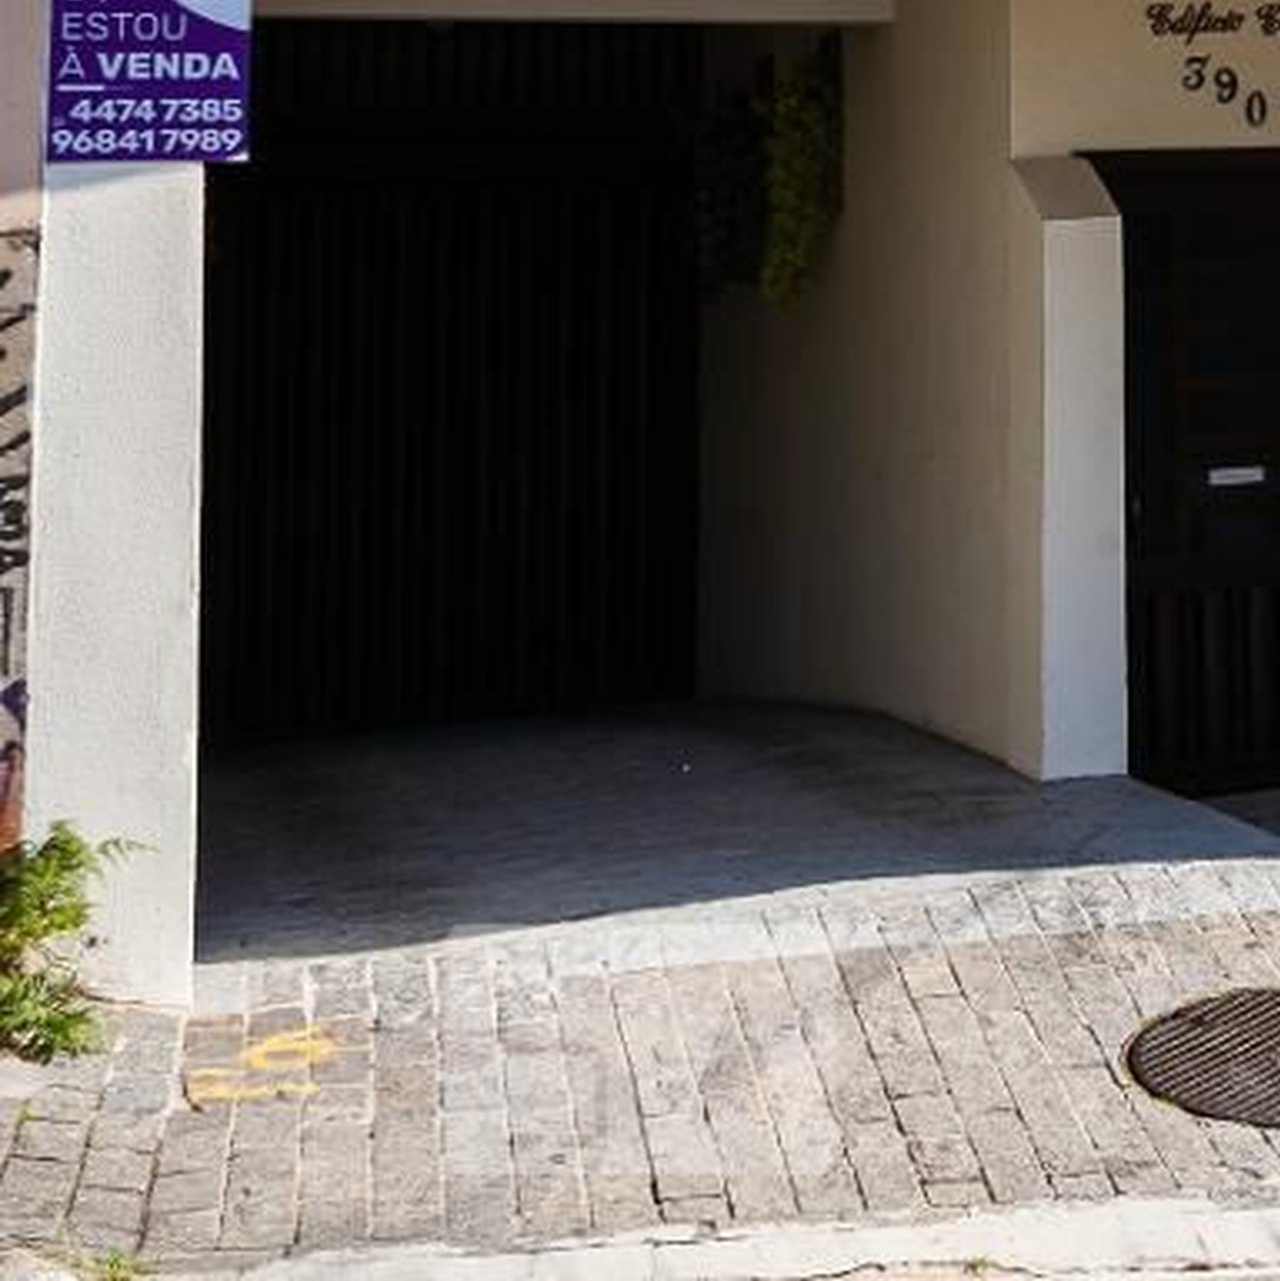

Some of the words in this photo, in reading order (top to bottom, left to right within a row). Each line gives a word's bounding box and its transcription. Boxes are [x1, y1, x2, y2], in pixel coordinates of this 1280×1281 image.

[61, 12, 188, 41] ESTOU
[57, 45, 86, 80] À
[96, 52, 240, 80] VENDA
[1181, 53, 1267, 127] 390
